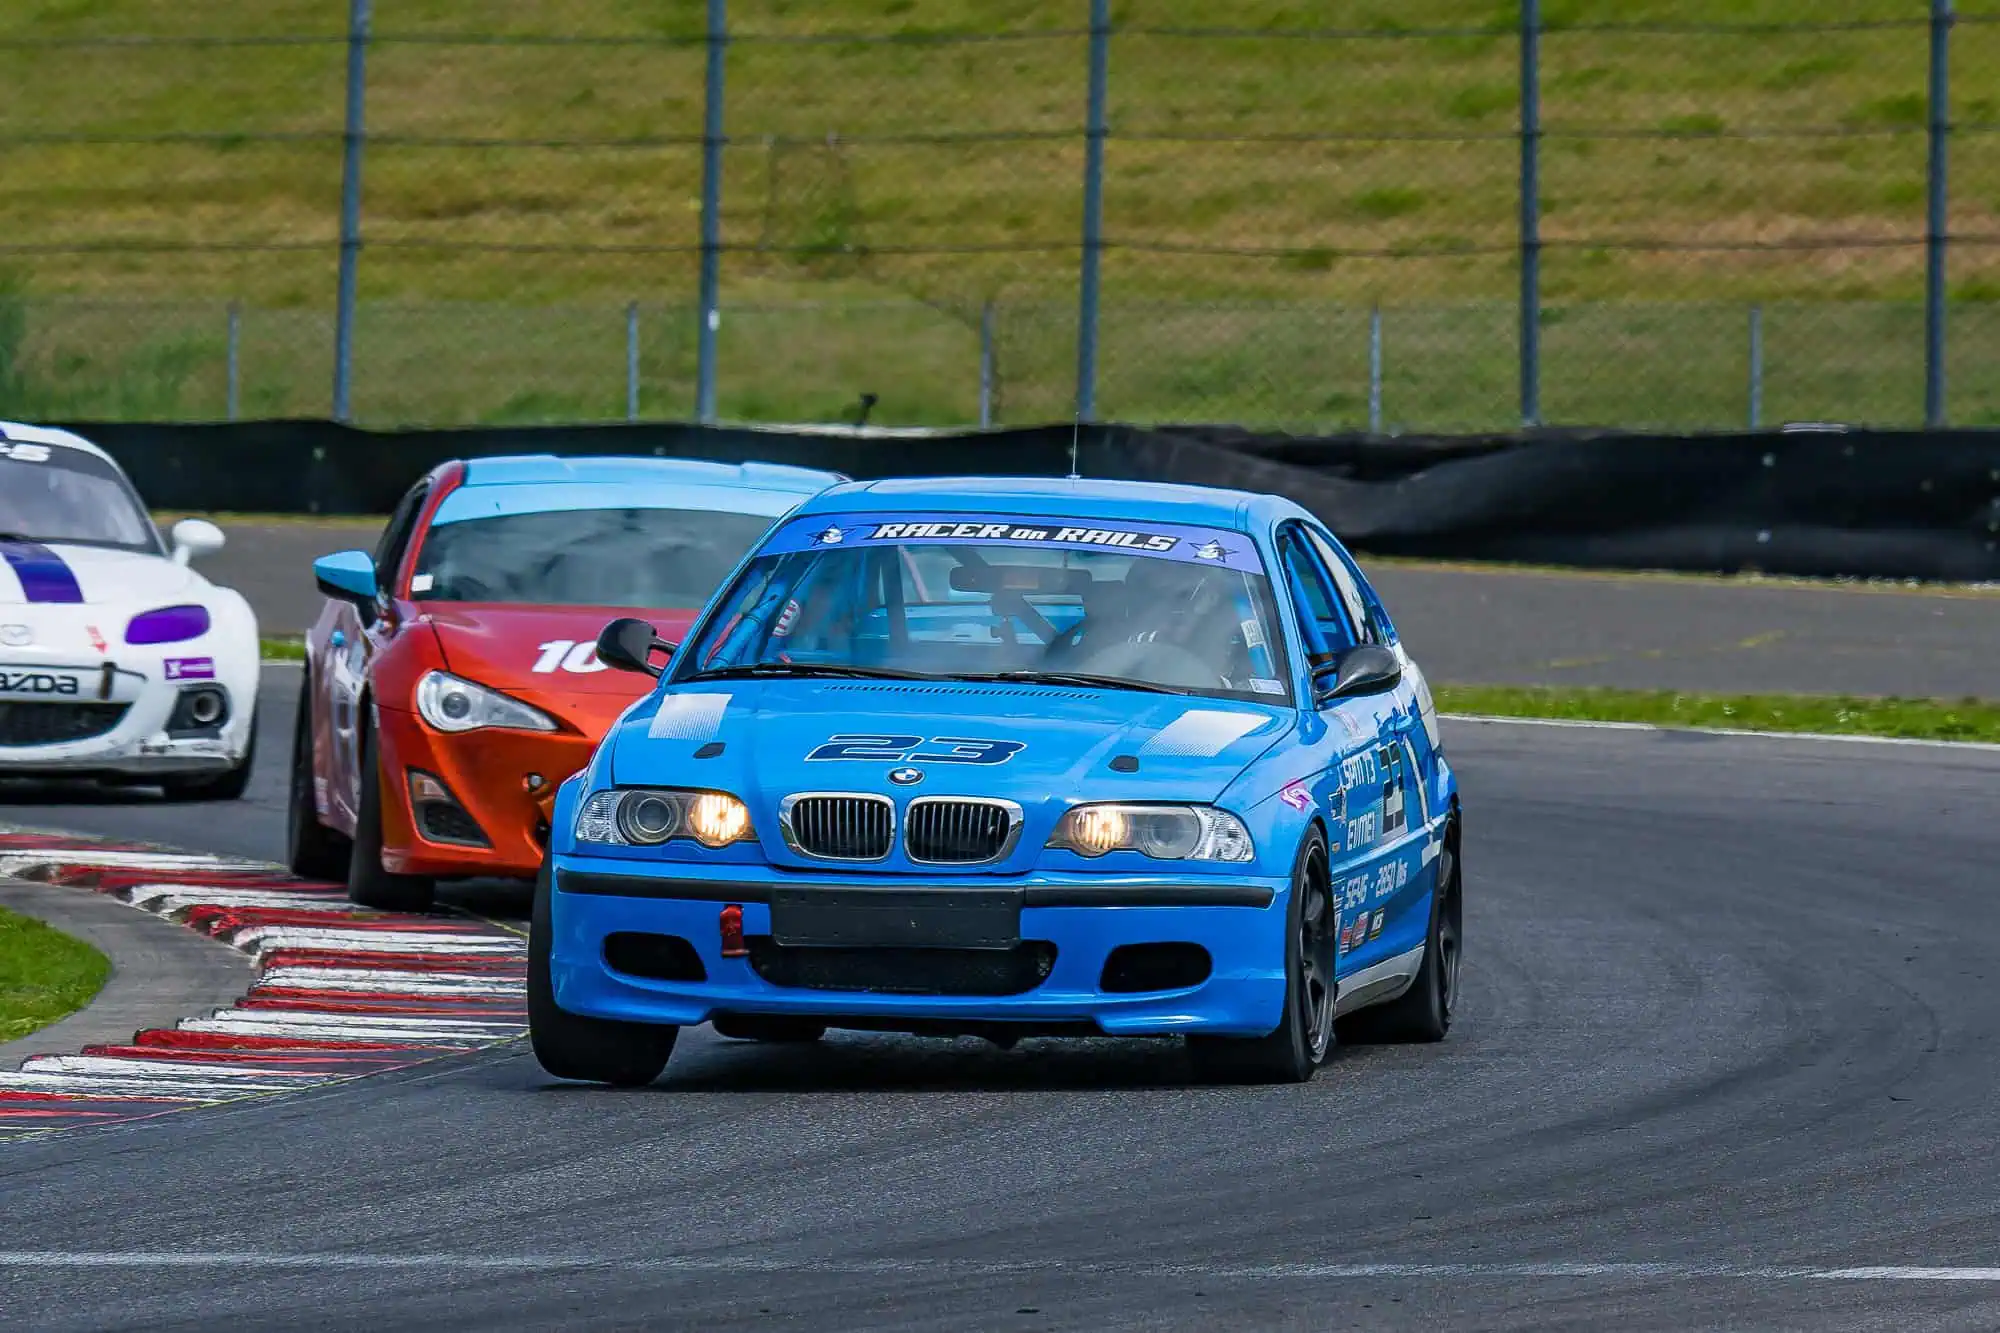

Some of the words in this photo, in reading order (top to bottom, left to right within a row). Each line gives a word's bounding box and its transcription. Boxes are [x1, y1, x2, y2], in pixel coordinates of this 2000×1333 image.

[873, 523, 1009, 539] RACER
[1010, 528, 1047, 540] on
[1053, 527, 1176, 551] RAILS
[804, 734, 1028, 766] 23
